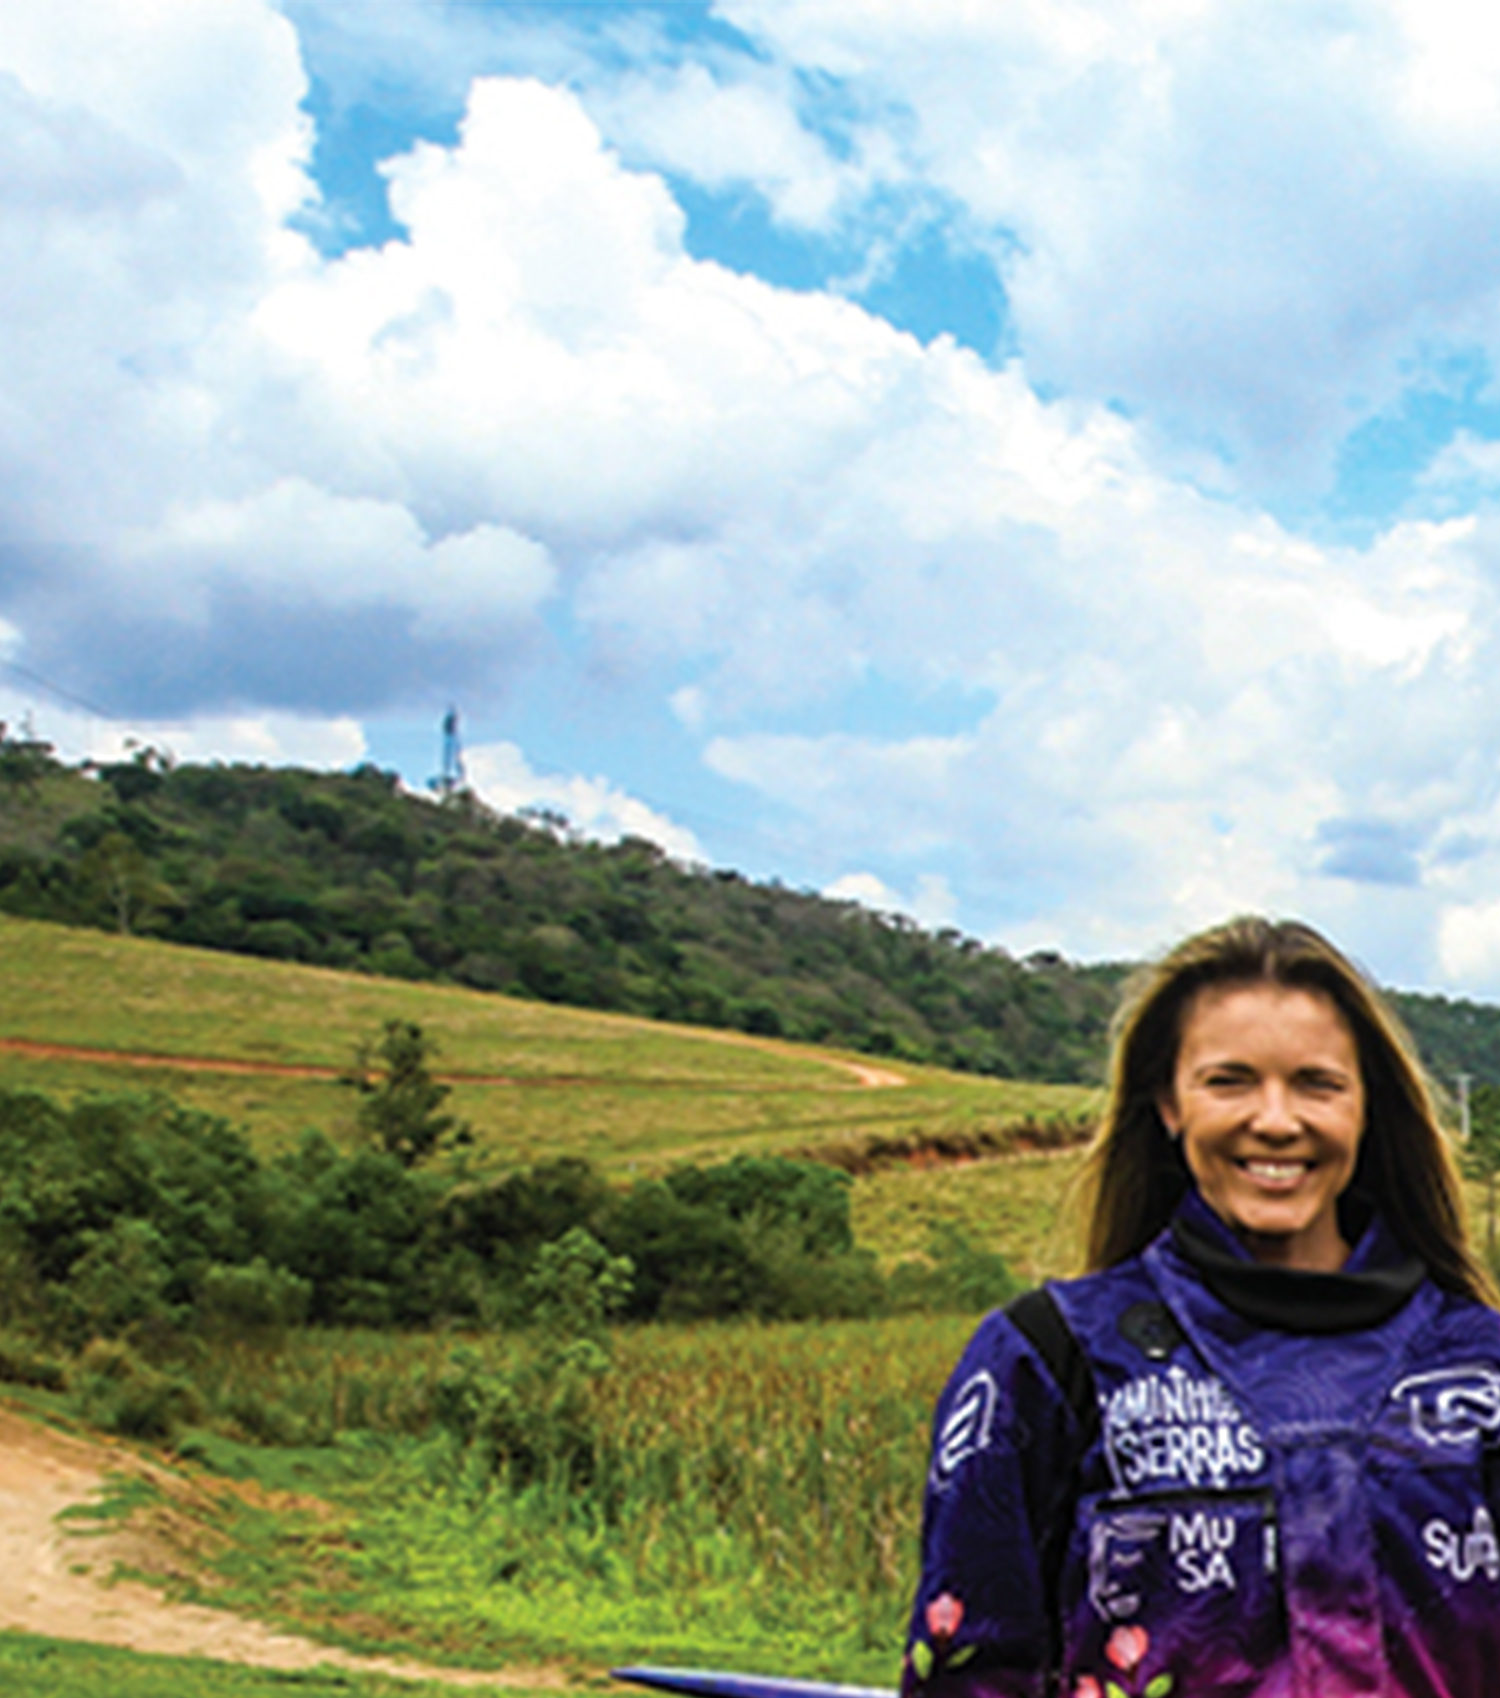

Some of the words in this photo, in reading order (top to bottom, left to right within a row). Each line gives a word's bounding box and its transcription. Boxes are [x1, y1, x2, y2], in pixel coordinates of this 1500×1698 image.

[1114, 1424, 1264, 1489] SERRAS
[1169, 1512, 1237, 1552] MU
[1176, 1550, 1236, 1593] SA
